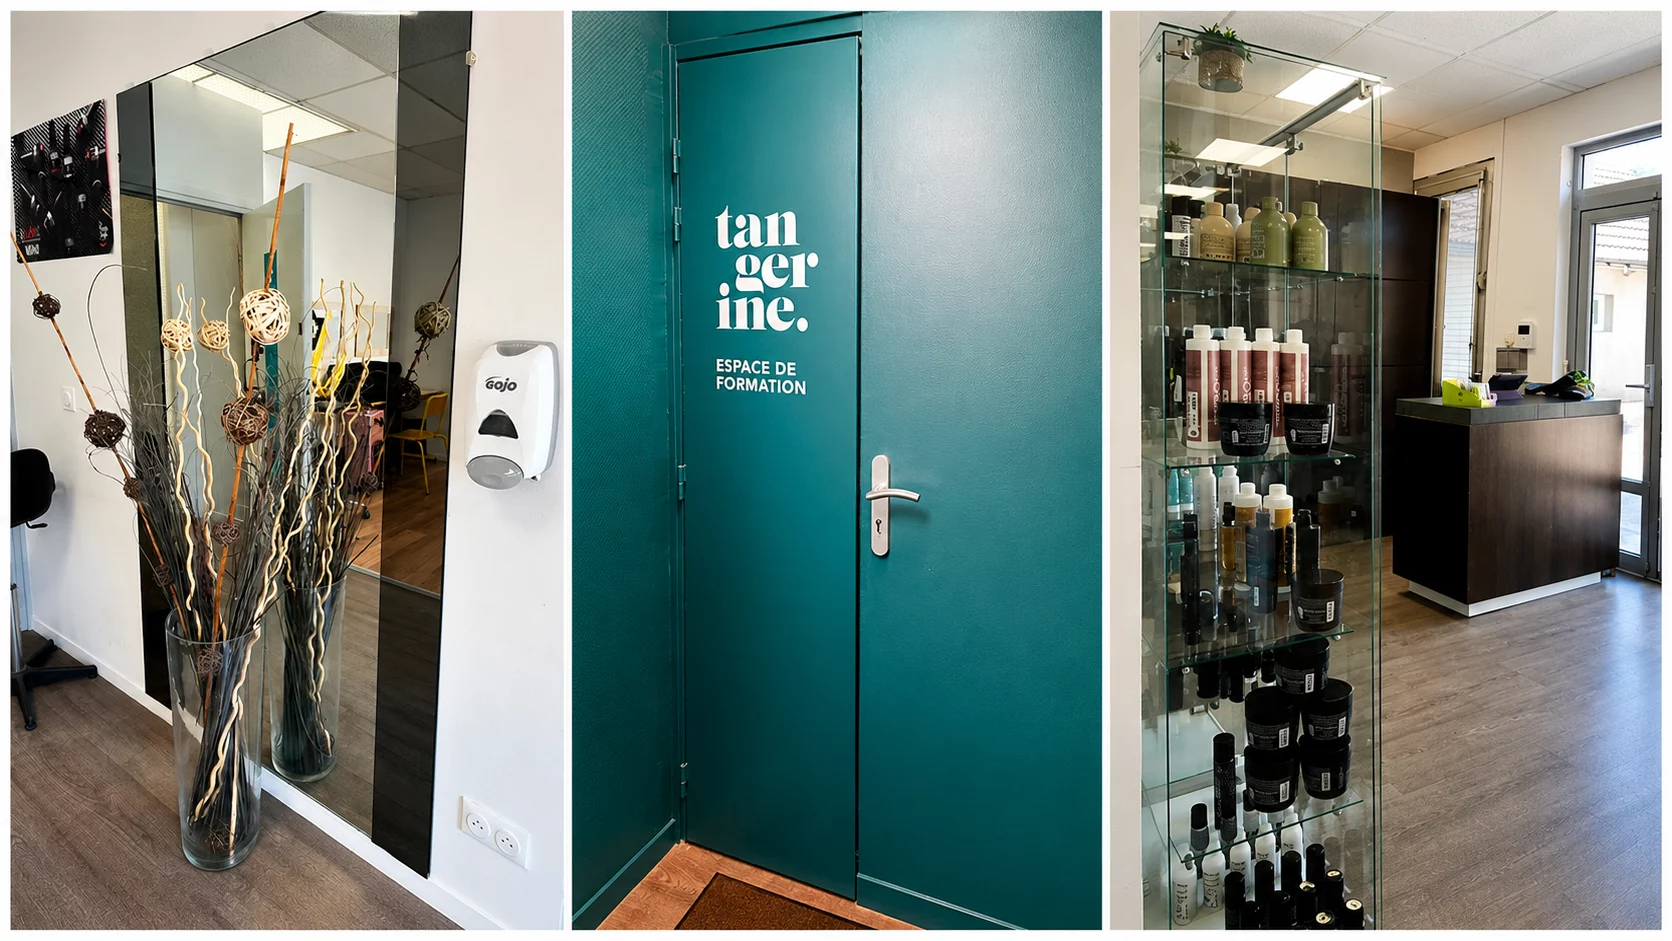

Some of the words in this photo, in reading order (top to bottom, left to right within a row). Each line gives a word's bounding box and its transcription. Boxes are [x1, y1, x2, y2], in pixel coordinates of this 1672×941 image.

[715, 205, 800, 249] tan
[735, 252, 819, 294] ger
[716, 282, 809, 332] ine.
[716, 358, 770, 375] ESPACE
[775, 361, 797, 376] DE
[716, 376, 807, 395] FORMATION
